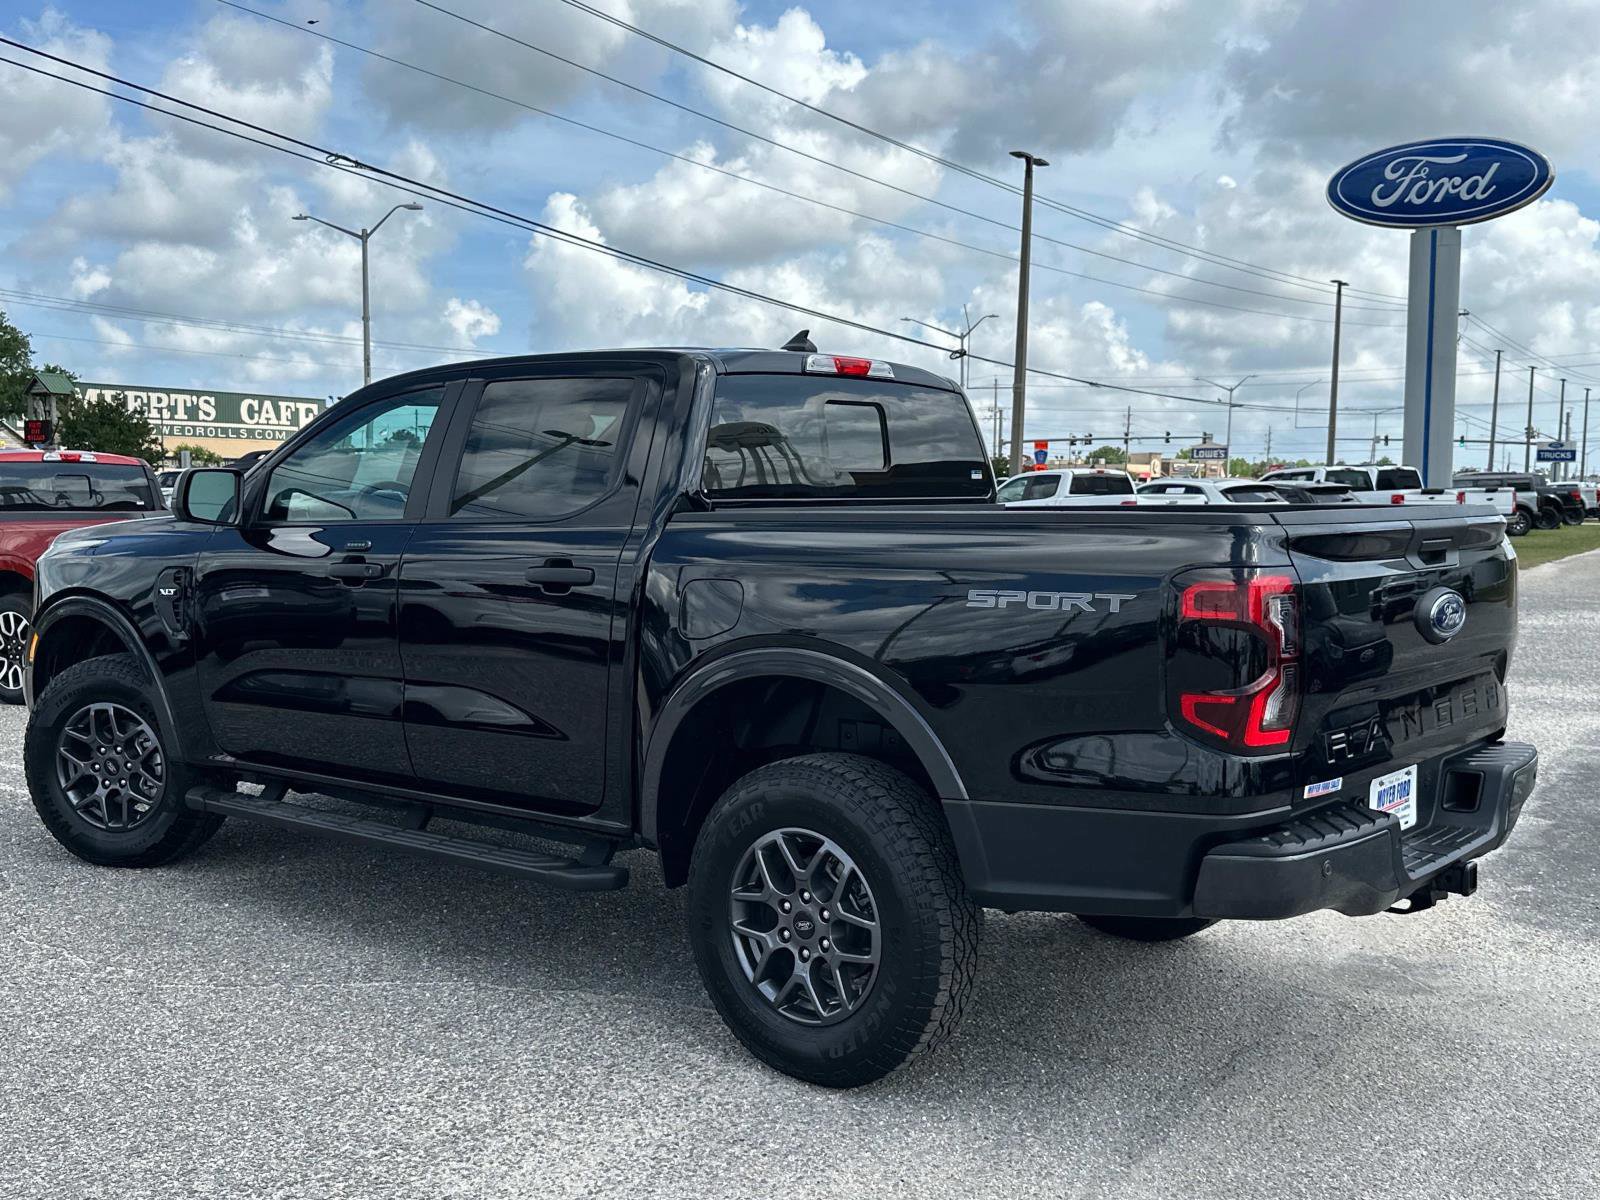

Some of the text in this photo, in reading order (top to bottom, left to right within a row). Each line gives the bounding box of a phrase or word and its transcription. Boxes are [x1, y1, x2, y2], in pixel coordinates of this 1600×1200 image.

[1371, 153, 1500, 207] Ford
[1540, 451, 1572, 459] TRUCKS
[160, 588, 177, 596] XLT
[966, 589, 1138, 613] SPORT
[1325, 682, 1500, 764] RANGER
[1377, 785, 1396, 809] MOYER
[1396, 779, 1411, 801] FORD
